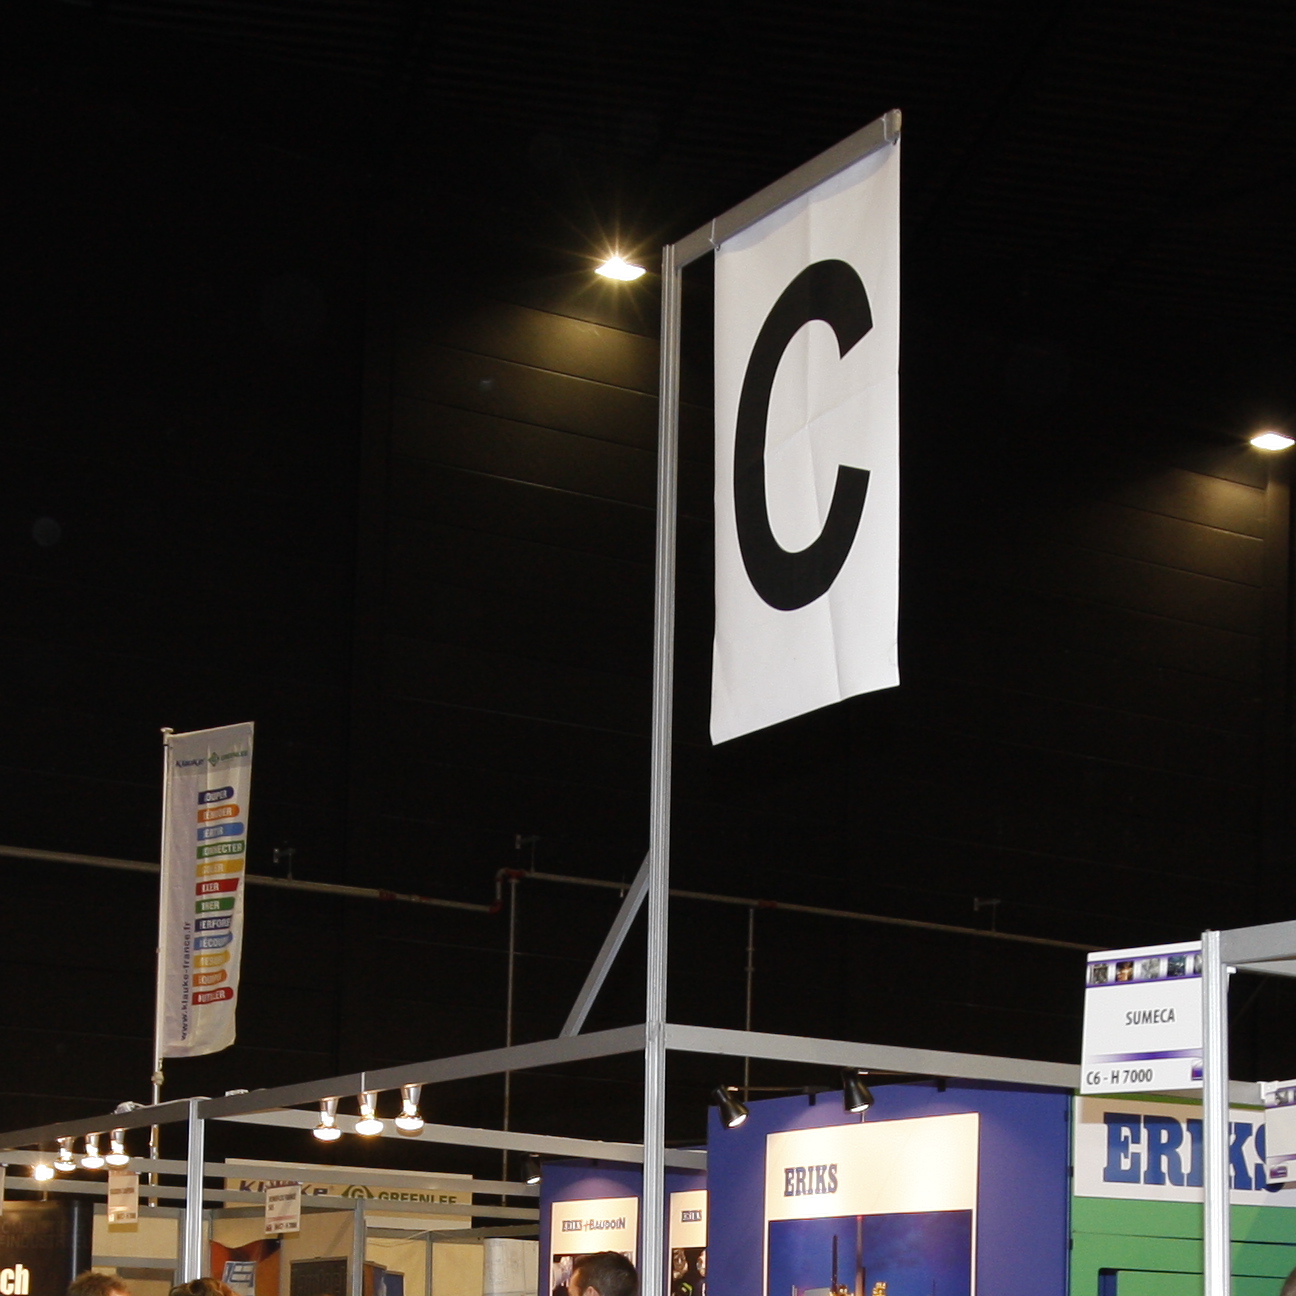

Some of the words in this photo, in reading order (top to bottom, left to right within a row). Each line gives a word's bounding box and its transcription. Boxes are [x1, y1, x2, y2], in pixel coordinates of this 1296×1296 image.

[733, 259, 874, 612] C
[1125, 1008, 1175, 1026] SUMECA
[1086, 1070, 1101, 1085] C6
[1111, 1069, 1120, 1084] H
[1123, 1068, 1153, 1083] 7000
[784, 1163, 838, 1197] ERIKS
